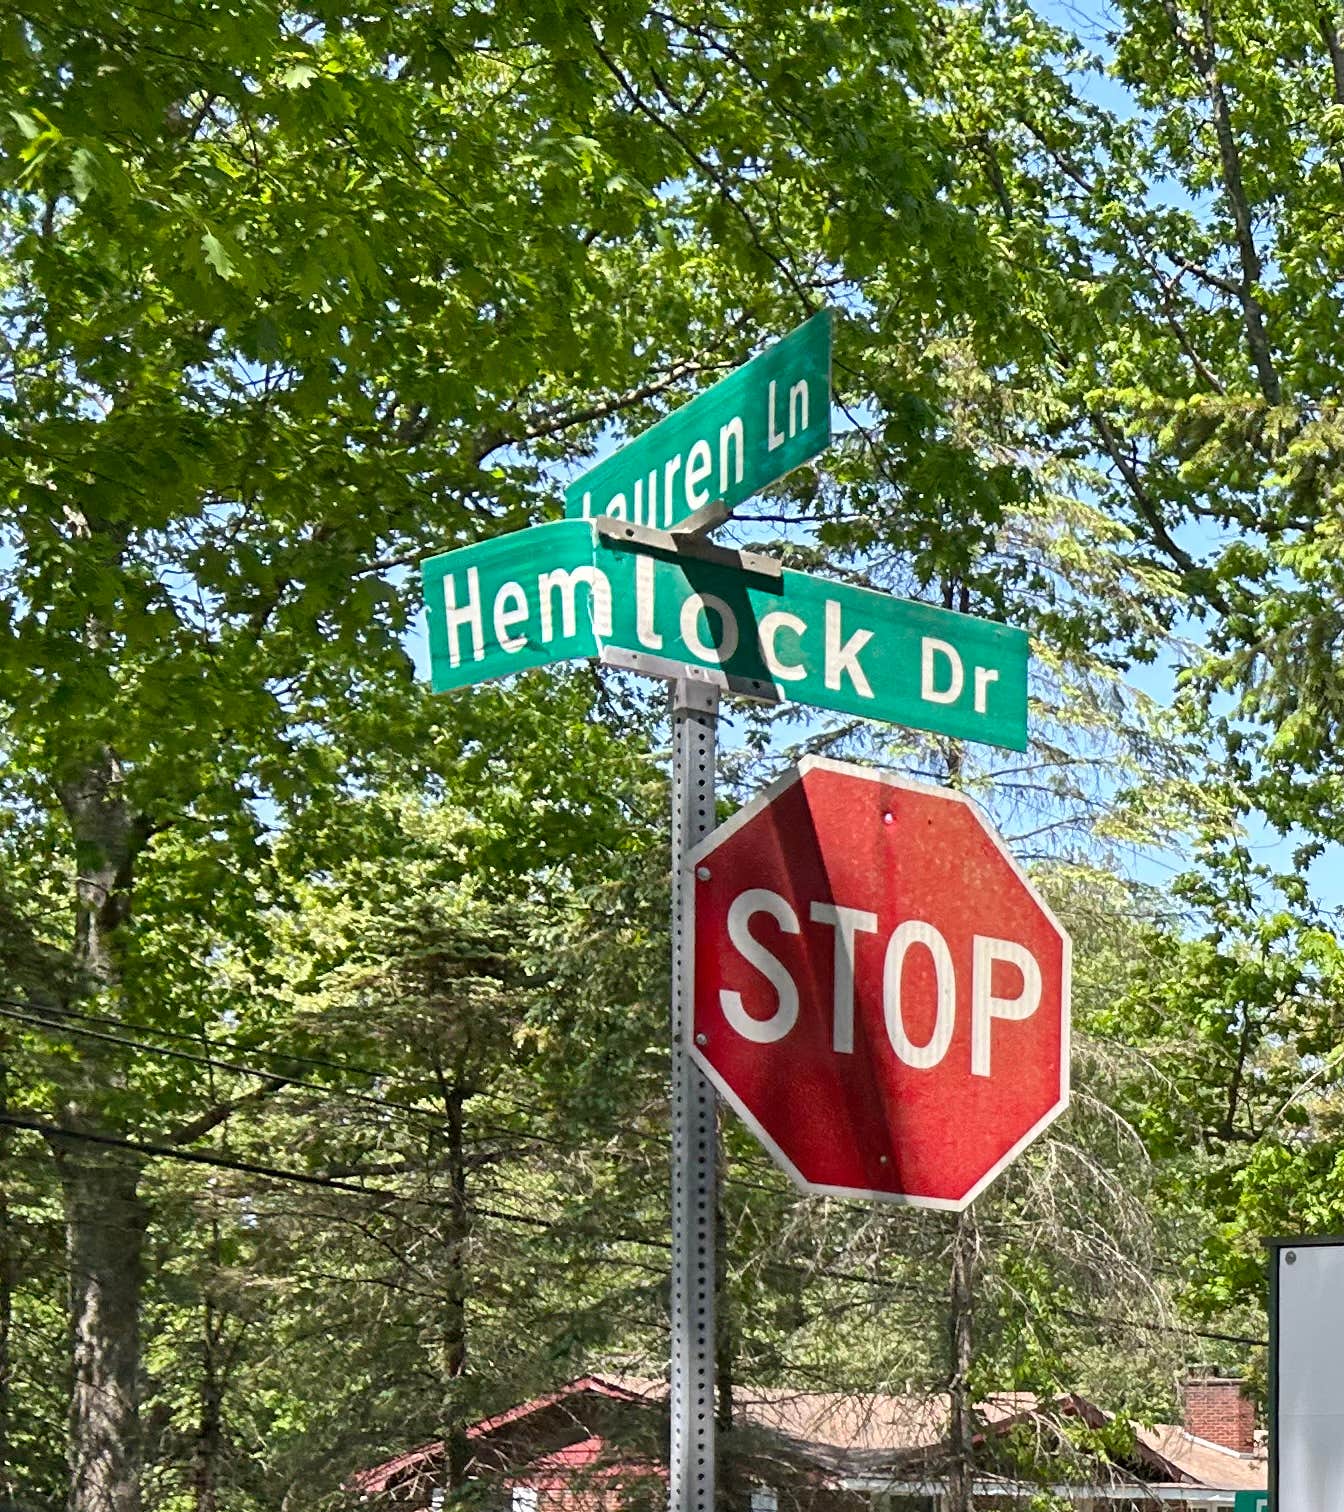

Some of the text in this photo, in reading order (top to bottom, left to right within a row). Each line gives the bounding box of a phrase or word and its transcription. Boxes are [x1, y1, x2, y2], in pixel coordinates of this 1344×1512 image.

[767, 379, 809, 453] Ln
[442, 556, 999, 714] Hemlock Dr
[719, 888, 1042, 1078] STOP
